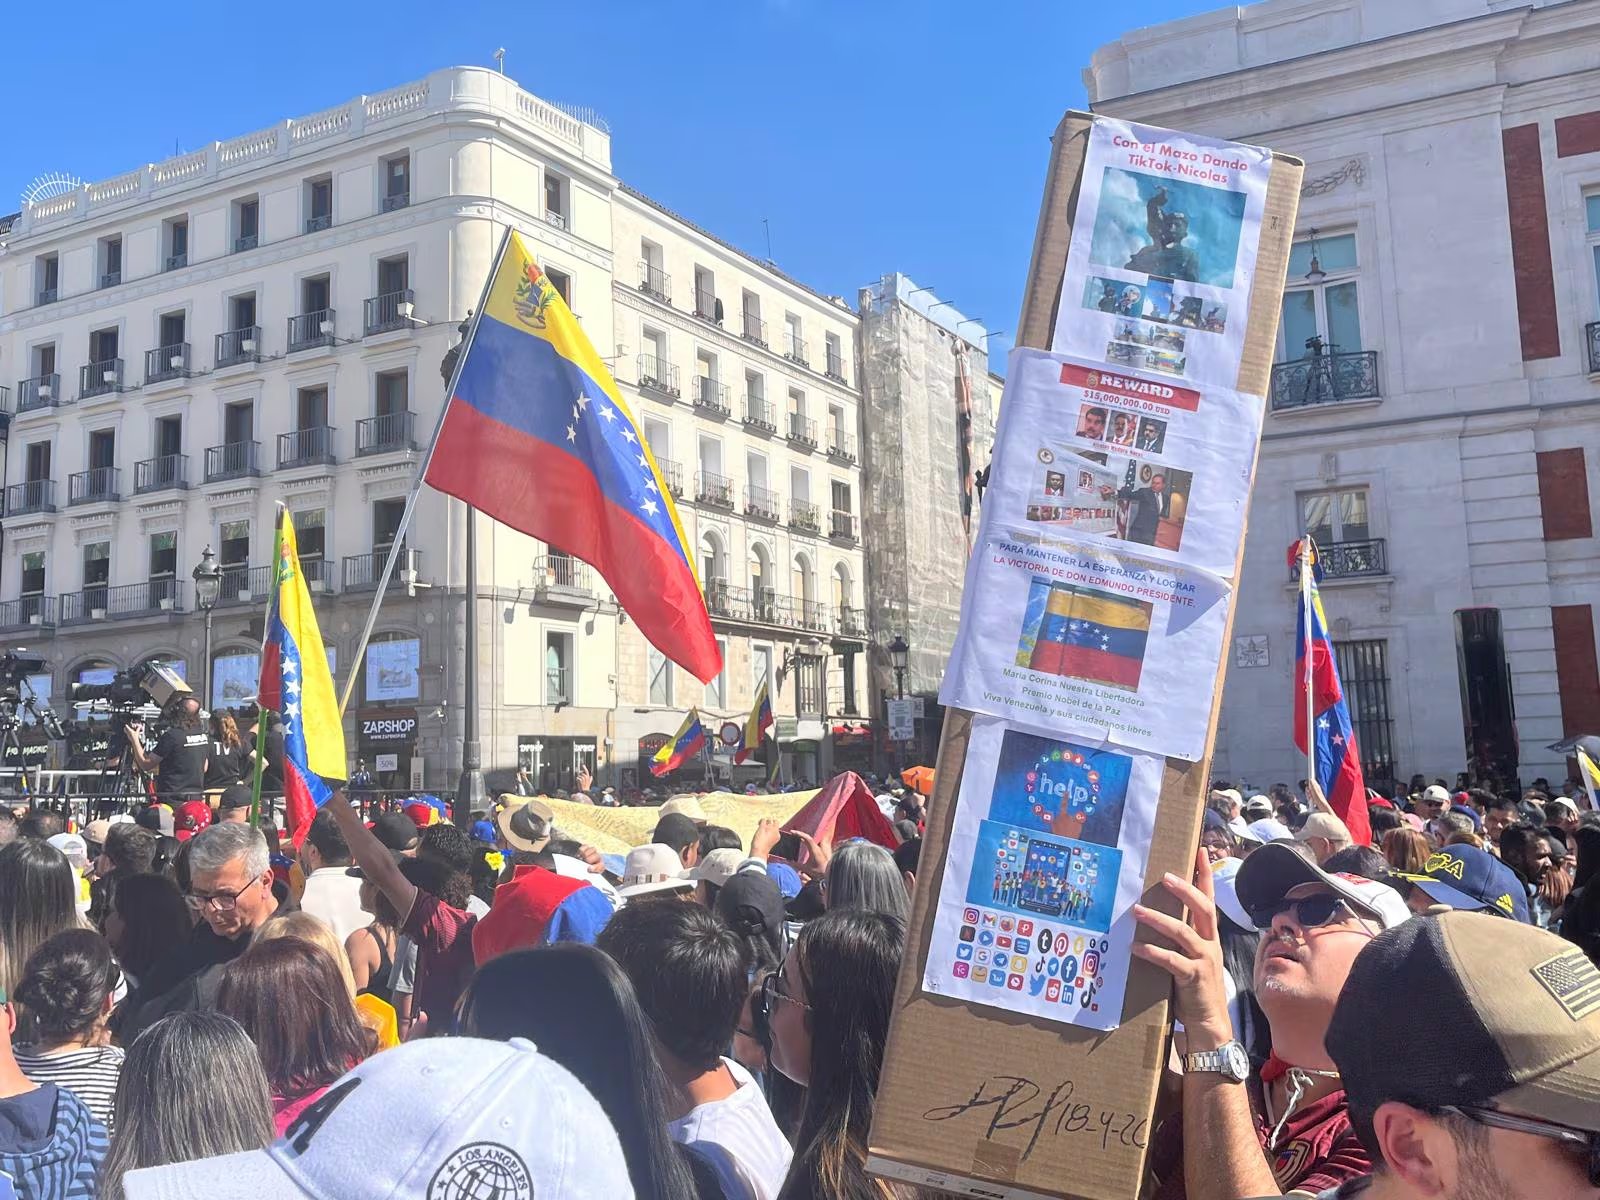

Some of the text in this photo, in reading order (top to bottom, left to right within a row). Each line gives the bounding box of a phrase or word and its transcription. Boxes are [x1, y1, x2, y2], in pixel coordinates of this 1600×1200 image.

[1113, 135, 1249, 172] Con el Mazo Dando
[1128, 154, 1228, 184] TikTok-Nicolas
[1084, 389, 1153, 412] $15,000,000.00
[1100, 374, 1174, 399] REWARD
[993, 555, 1006, 566] LA
[1007, 557, 1051, 575] VICTORIA
[1052, 567, 1065, 578] DE
[1066, 570, 1087, 584] DON
[1088, 574, 1135, 594] EDMUNDO
[999, 542, 1025, 556] PARA
[1026, 547, 1077, 567] MANTENER
[1078, 557, 1091, 569] LA
[1092, 560, 1148, 583] ESPERANZA
[1149, 574, 1156, 584] Y
[1156, 577, 1196, 593] LOGRAR
[1022, 686, 1121, 716] Premio Nobel de la Paz
[1028, 673, 1057, 688] Corina
[1059, 681, 1095, 697] Nuestra
[1095, 689, 1146, 708] Libertadora
[363, 719, 415, 734] ZAPSHOP
[983, 691, 1153, 738] Viva Venezuela y sus ciudadanos libres
[213, 741, 230, 756] TV
[1040, 773, 1089, 806] help
[458, 1148, 528, 1191] LOS ANGELES
